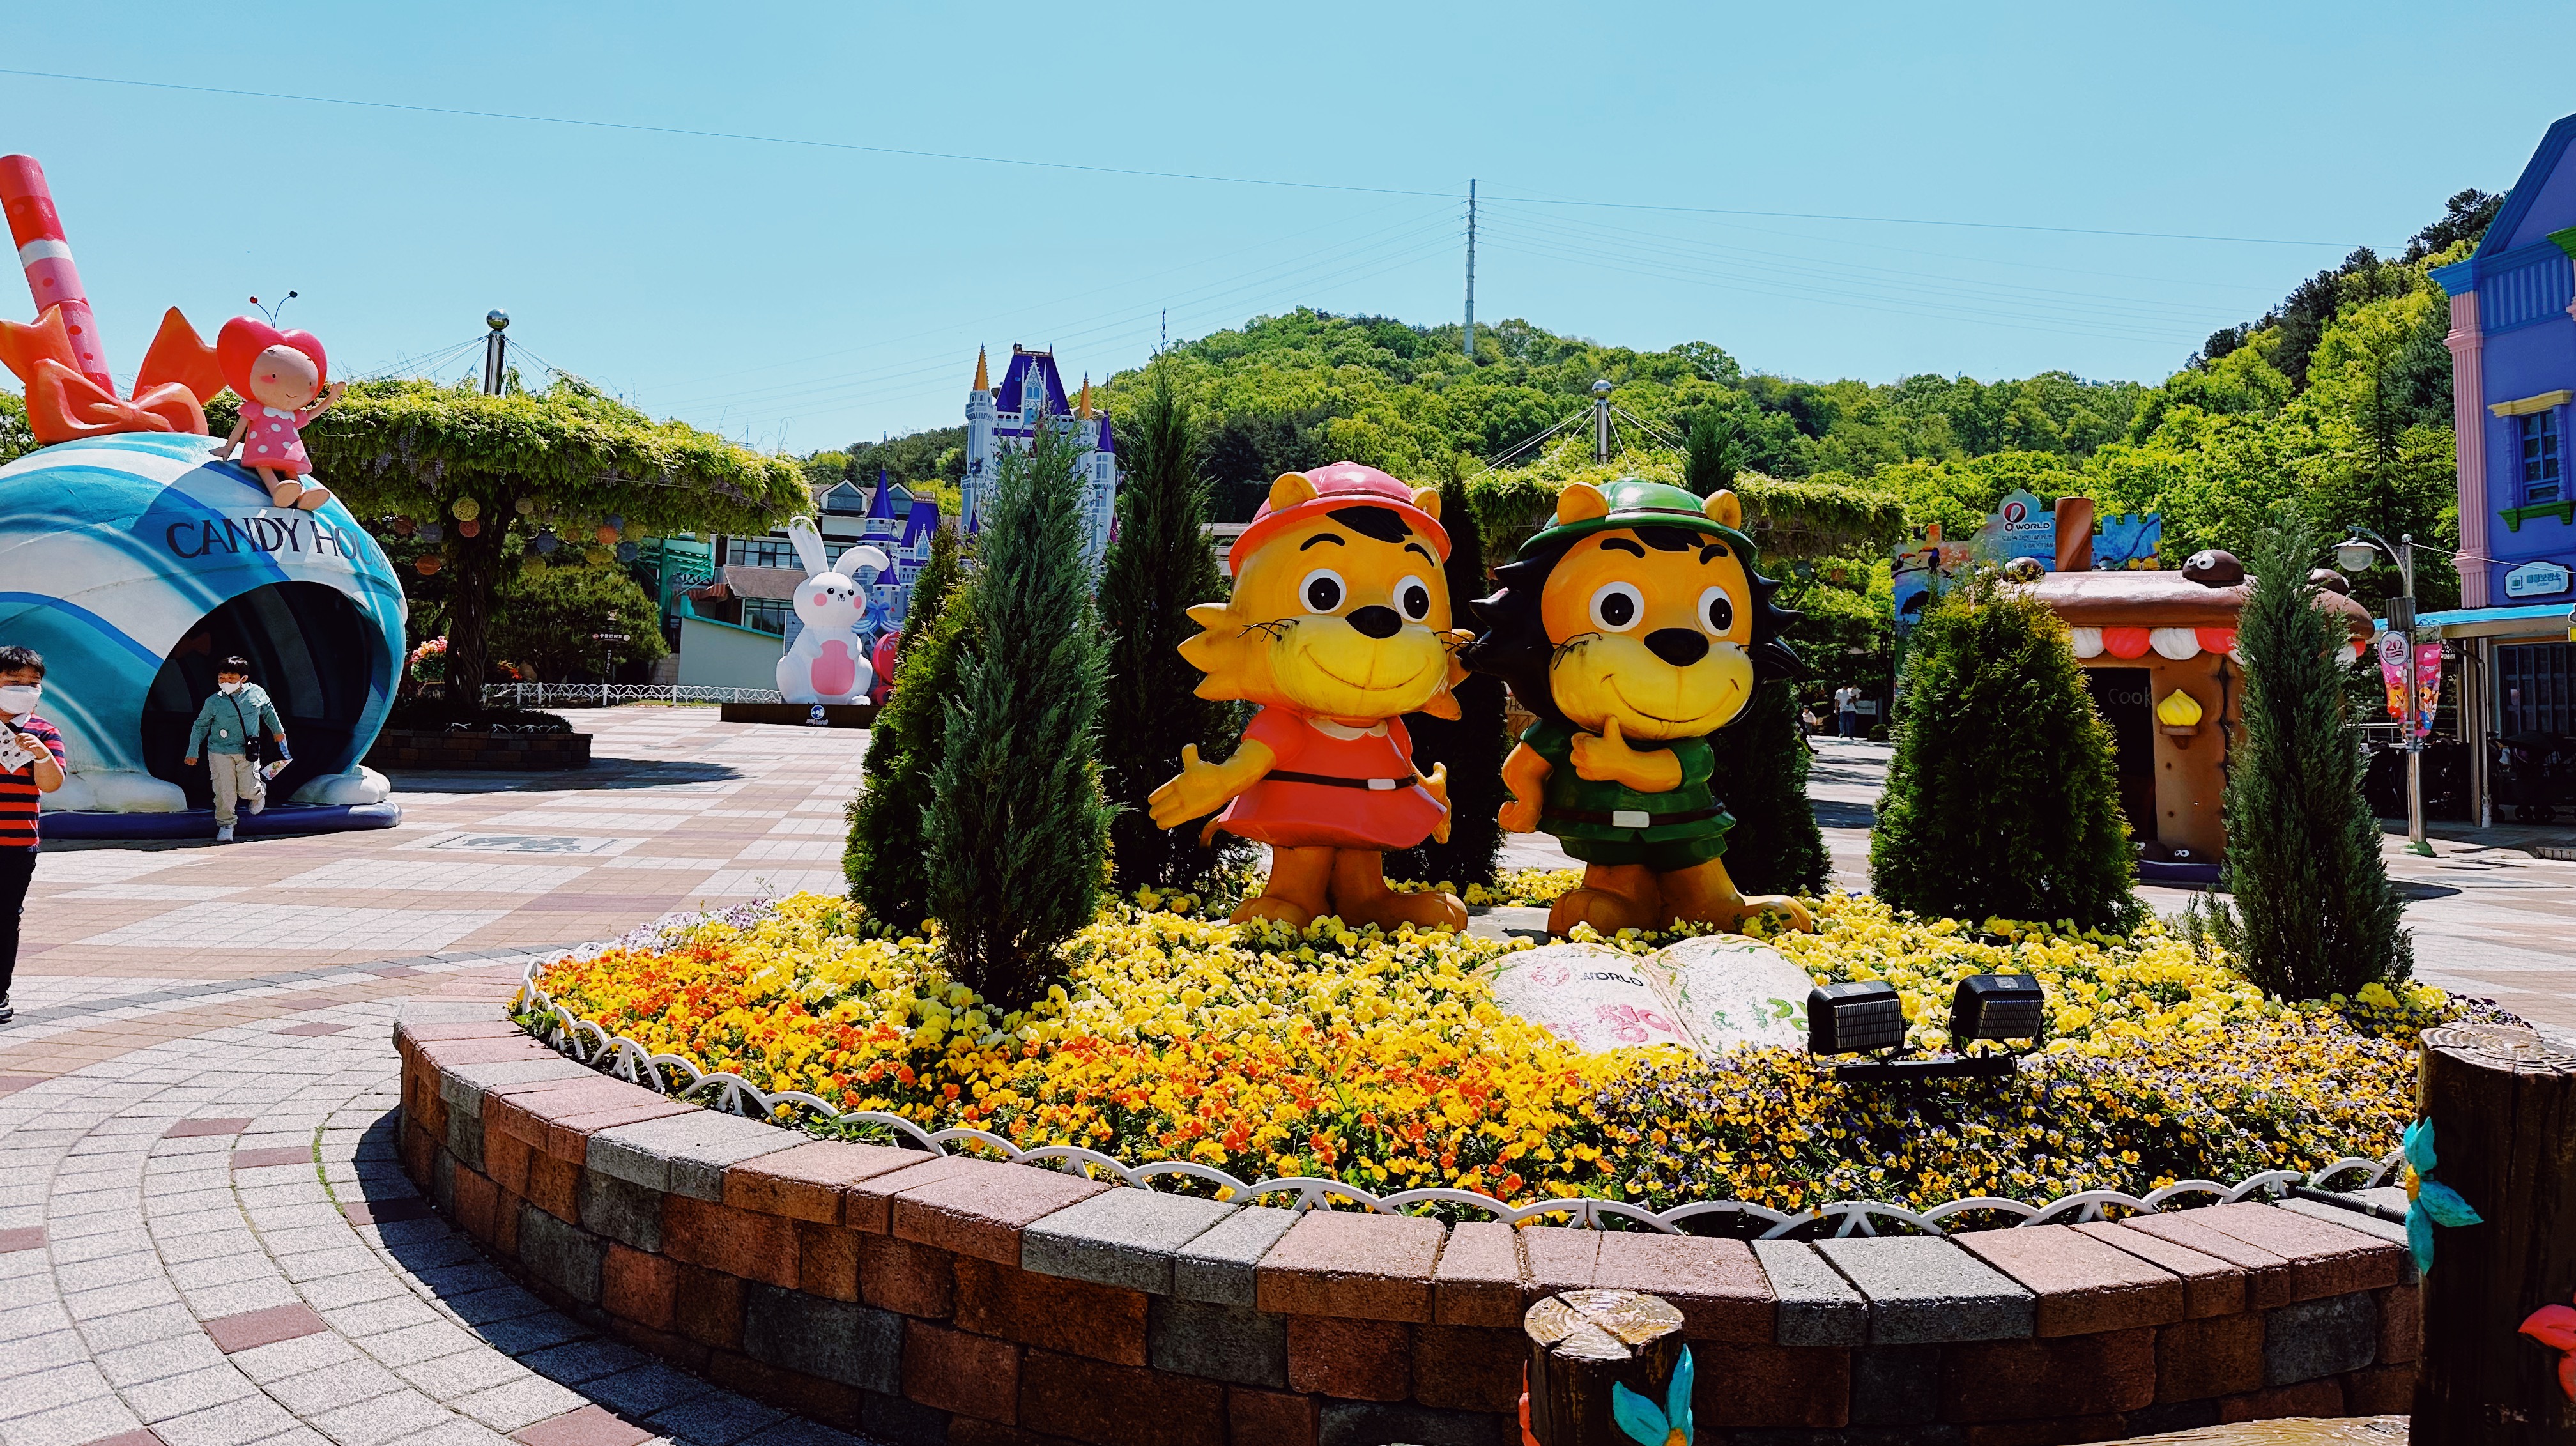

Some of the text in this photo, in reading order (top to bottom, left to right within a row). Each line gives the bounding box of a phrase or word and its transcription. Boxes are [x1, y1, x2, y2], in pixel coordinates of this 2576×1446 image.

[166, 518, 392, 578] CANDY HOUSE
[1508, 698, 1528, 712] HO
[2108, 686, 2152, 708] Cook
